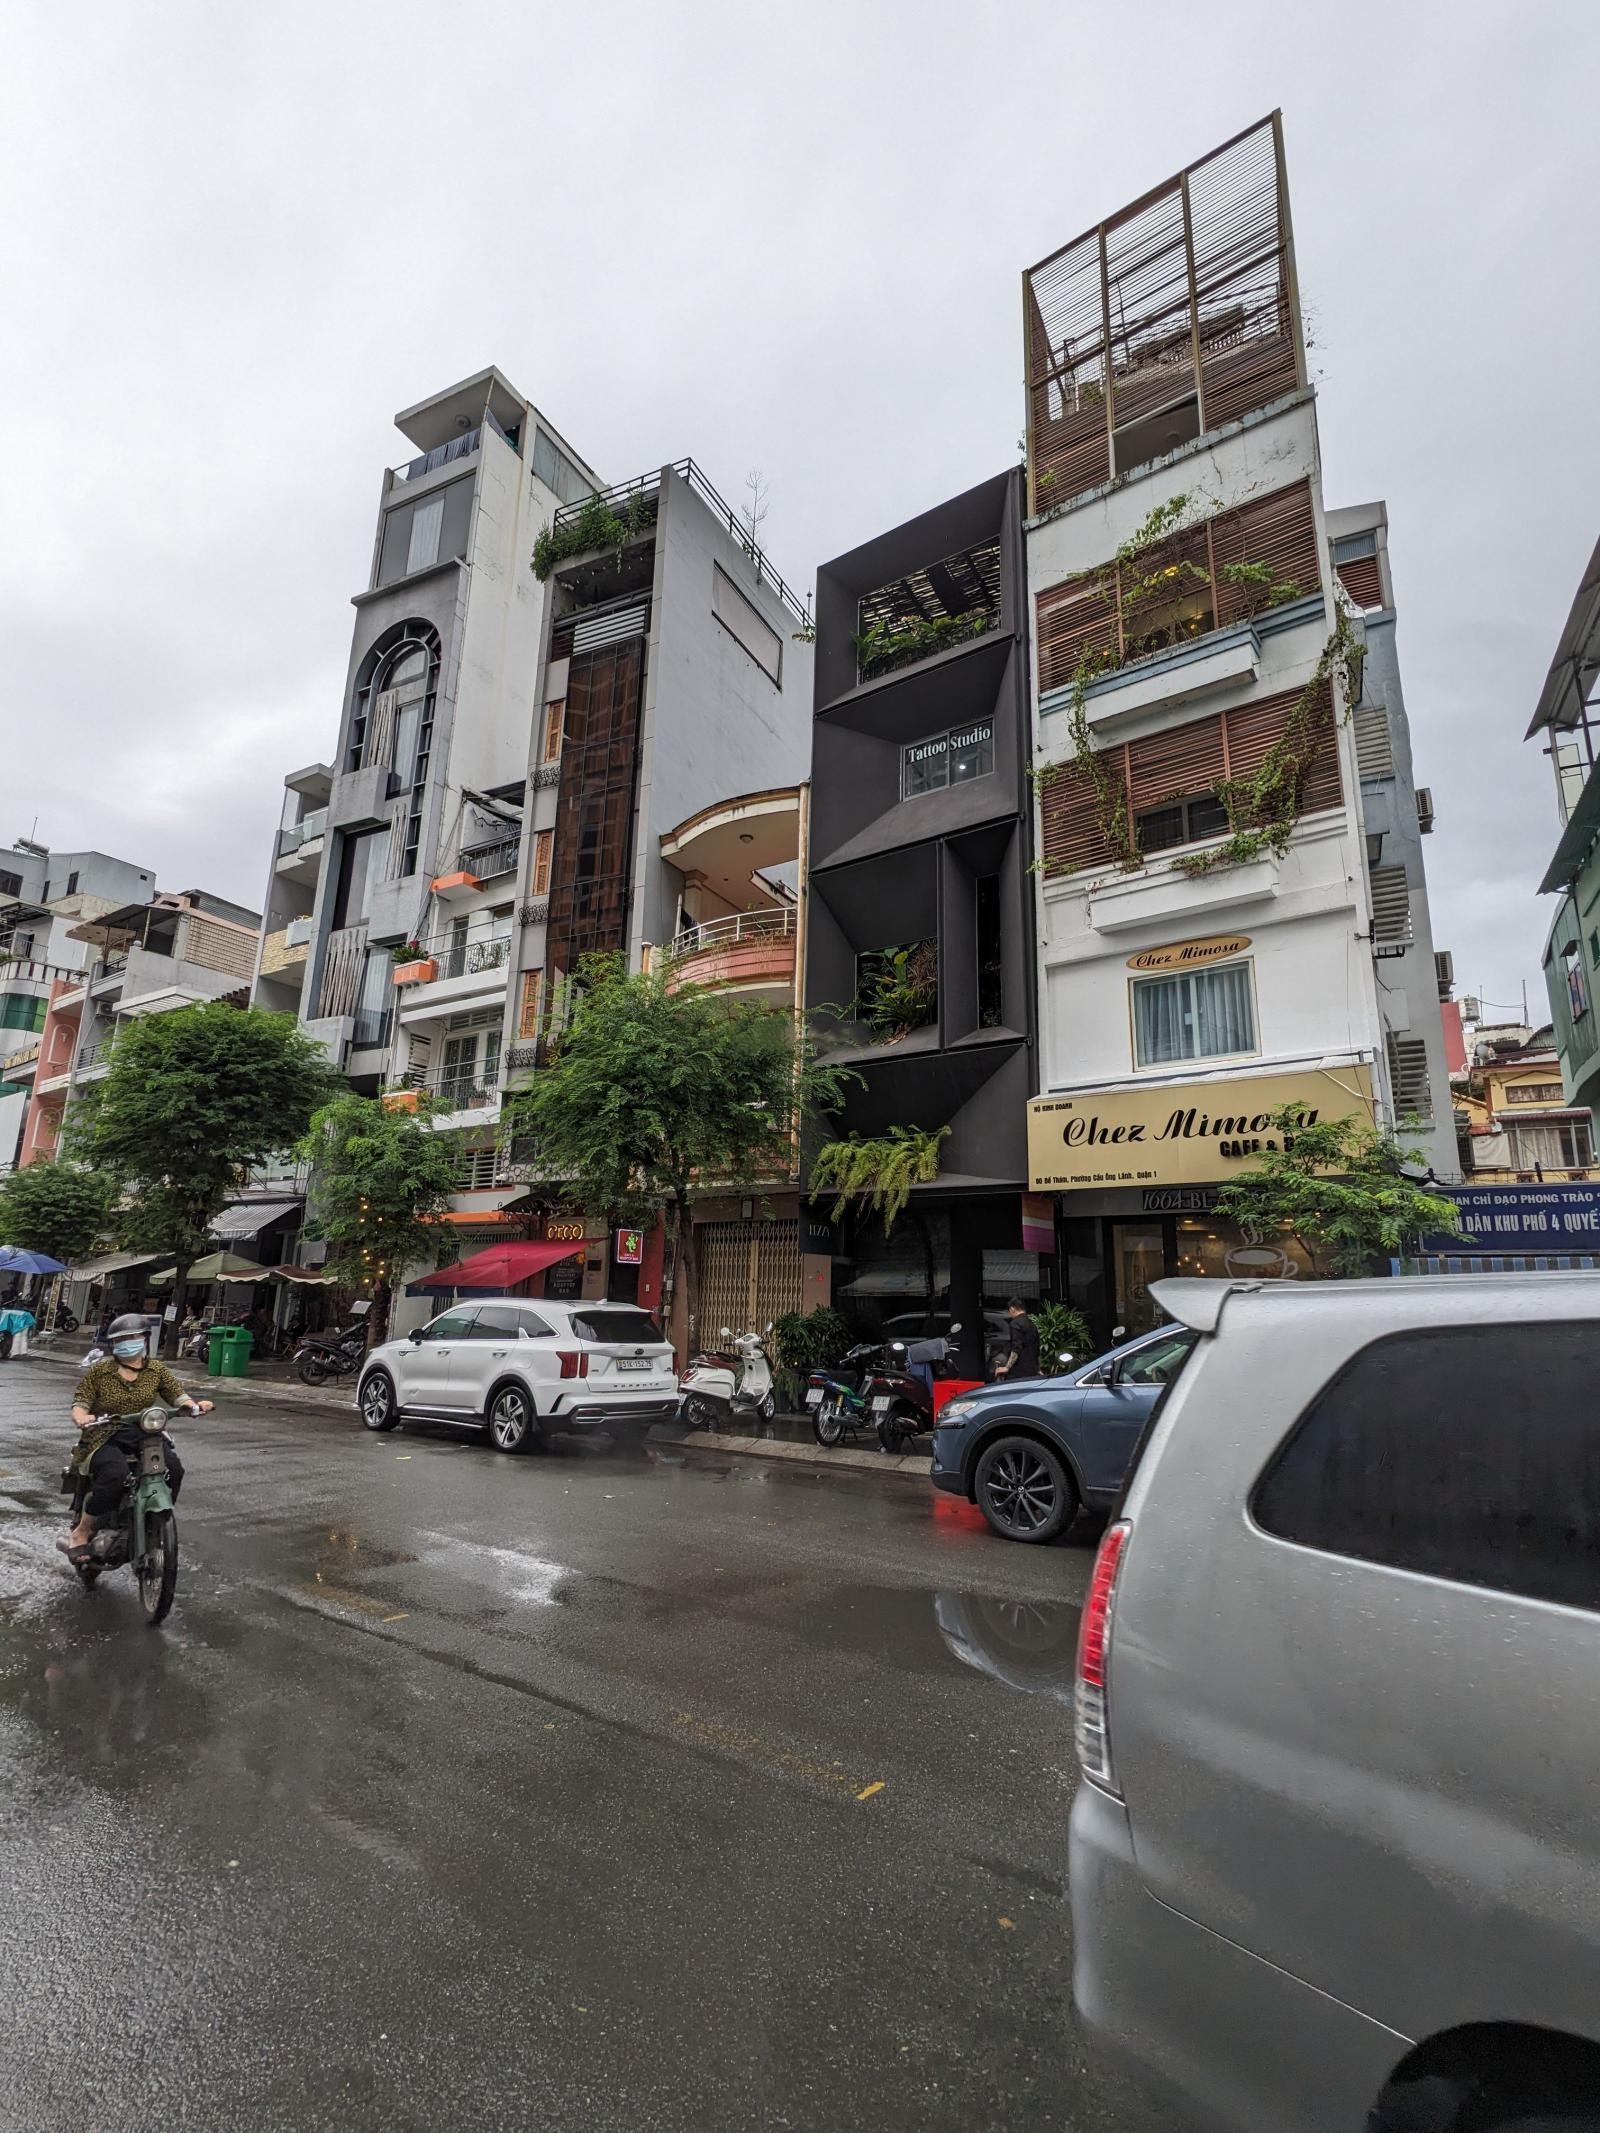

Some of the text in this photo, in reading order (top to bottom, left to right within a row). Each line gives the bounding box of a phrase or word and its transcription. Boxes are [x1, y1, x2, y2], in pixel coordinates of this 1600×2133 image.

[908, 727, 991, 763] Tattoo Studio
[1136, 942, 1240, 968] Chez Mimosa
[1063, 1107, 1319, 1148] Chez Mimoa
[1220, 1138, 1260, 1157] CAFE
[1266, 1140, 1278, 1152] &
[1143, 1189, 1184, 1210] 1664
[1472, 1192, 1492, 1205] CHỈ
[1495, 1194, 1518, 1206] ĐẠO
[1520, 1193, 1559, 1204] PHONG
[1561, 1190, 1594, 1203] TRÀO
[1466, 1212, 1492, 1232] DÂN
[1494, 1214, 1520, 1232] KHU
[1523, 1209, 1548, 1232] PHỐ
[1551, 1214, 1560, 1231] 4
[1564, 1208, 1600, 1233] QUYẾ
